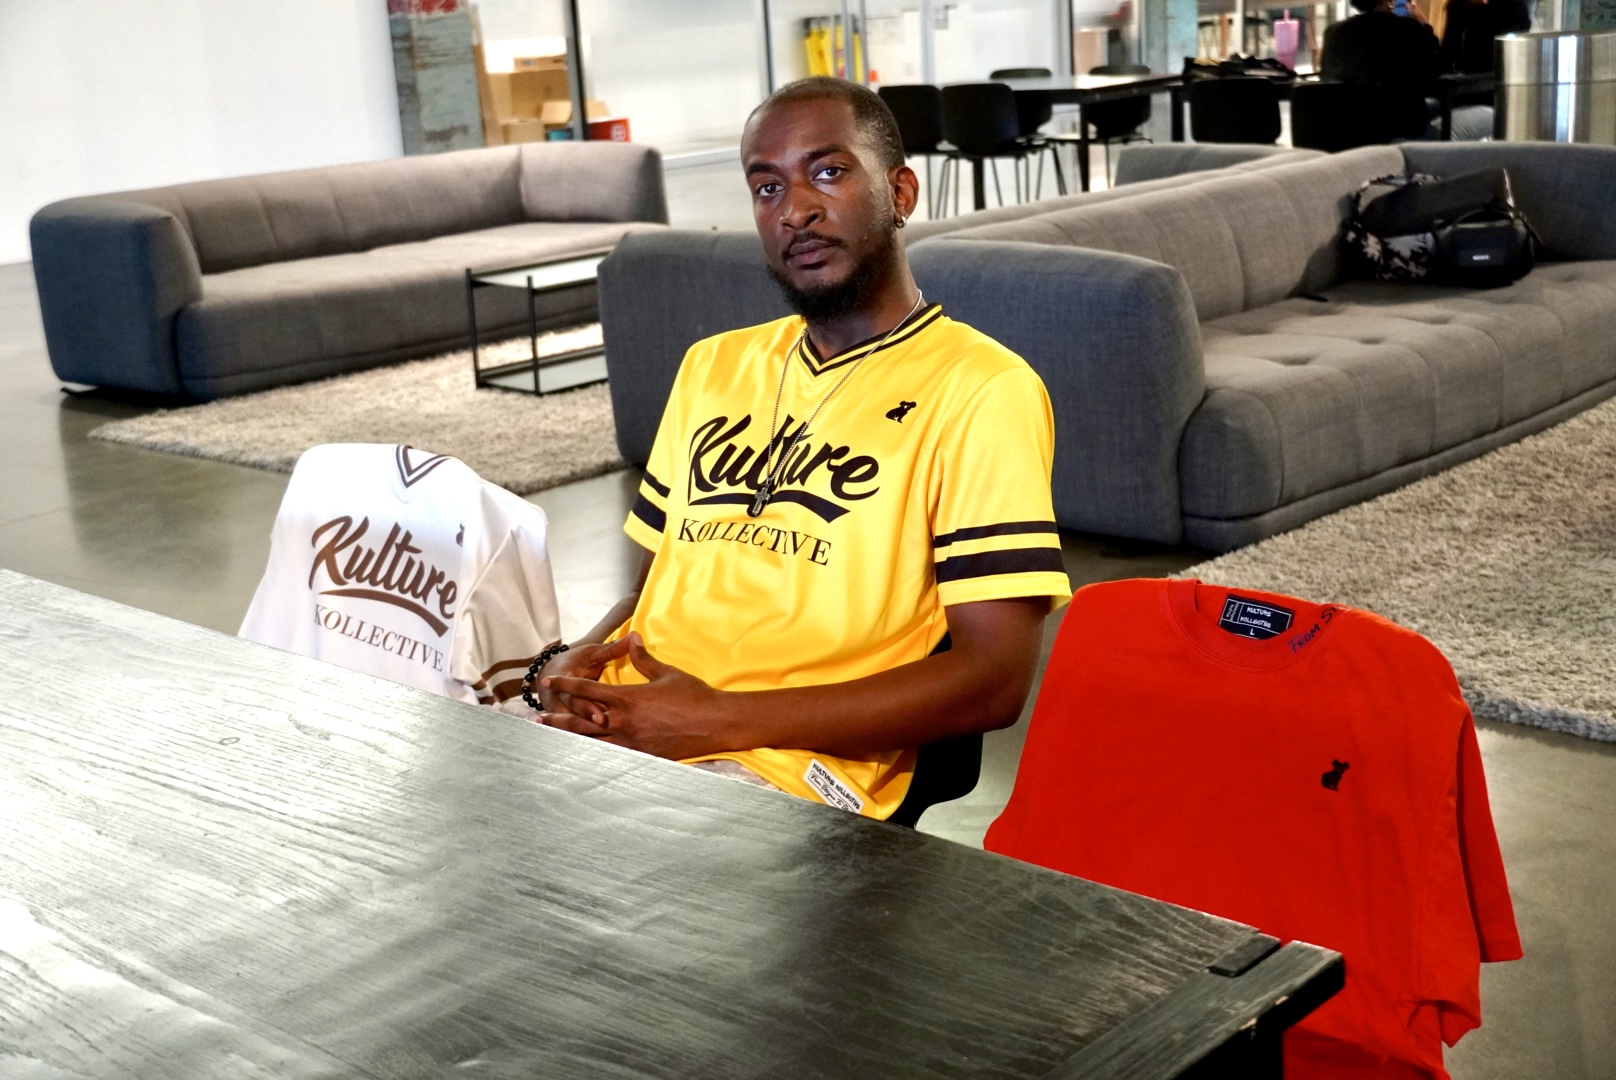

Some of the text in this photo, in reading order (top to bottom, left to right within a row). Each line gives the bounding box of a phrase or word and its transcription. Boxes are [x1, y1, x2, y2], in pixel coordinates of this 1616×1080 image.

[688, 413, 880, 501] Kulture
[677, 517, 832, 567] KOLLECTIVE
[308, 515, 457, 620] Kulture
[1246, 606, 1272, 617] KULTURE
[313, 603, 444, 672] KOLLECTIVE
[1249, 628, 1255, 636] L
[1286, 623, 1321, 653] FROM
[812, 762, 835, 786] KULTURE
